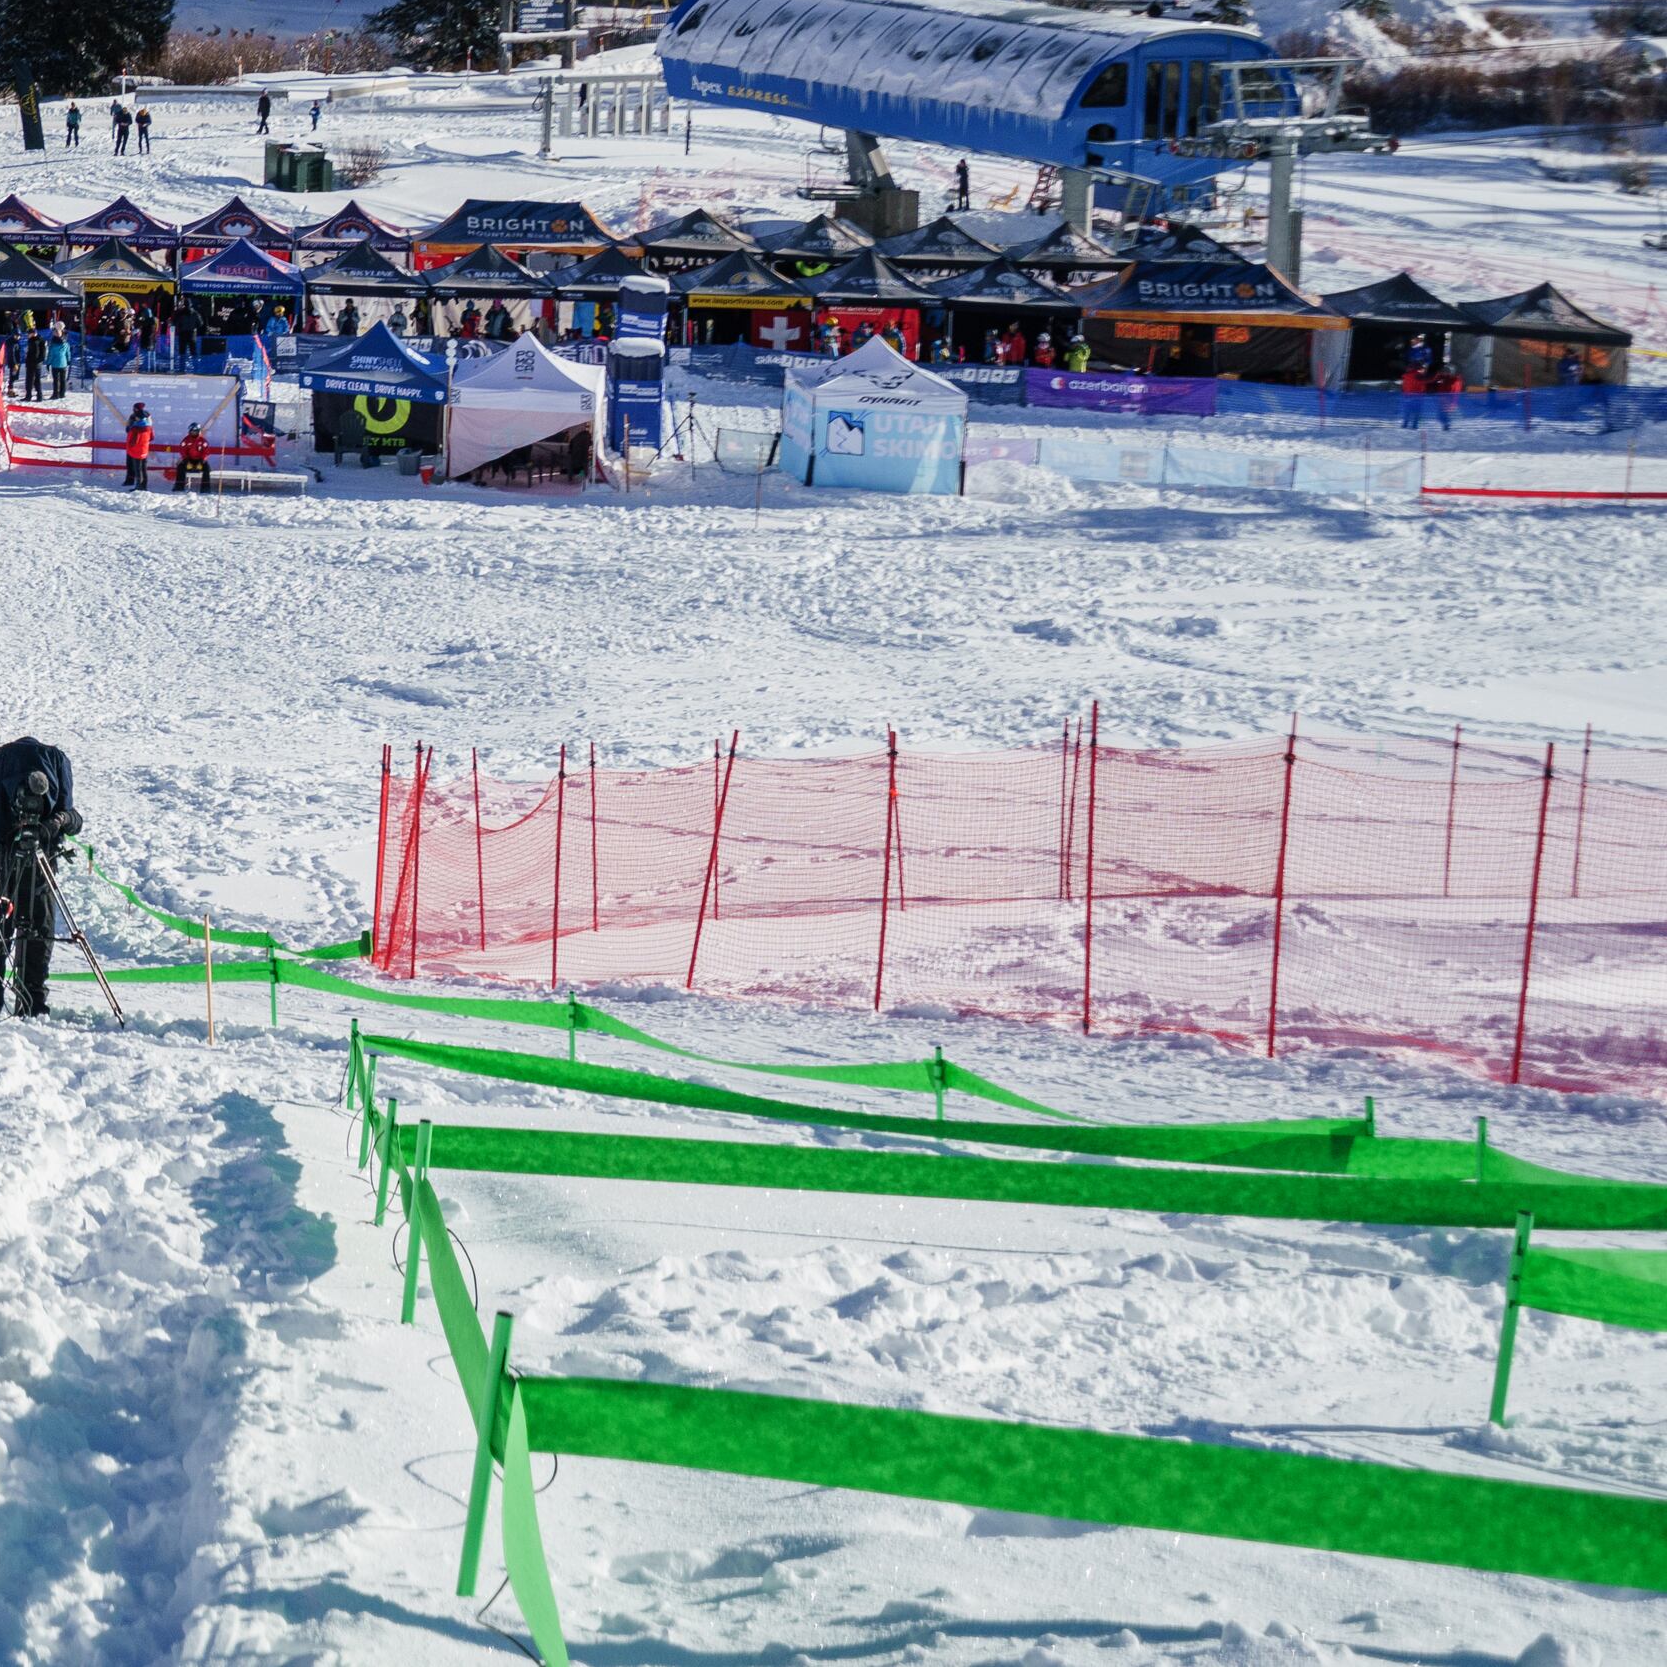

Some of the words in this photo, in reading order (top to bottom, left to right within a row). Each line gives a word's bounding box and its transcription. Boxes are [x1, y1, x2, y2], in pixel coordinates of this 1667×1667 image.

[691, 76, 723, 96] Apex
[727, 86, 788, 105] EXPRESS
[70, 235, 101, 243] Brighton
[467, 231, 523, 239] MOUNTAIN
[349, 363, 403, 373] CARWASH
[325, 378, 346, 390] DRIVE
[347, 381, 372, 393] CLEAN.
[374, 383, 396, 395] DRIVE
[396, 386, 423, 399] HAPPY.
[858, 396, 922, 406] DYNAFIT
[382, 437, 405, 447] MTB
[873, 439, 956, 460] SKIMO
